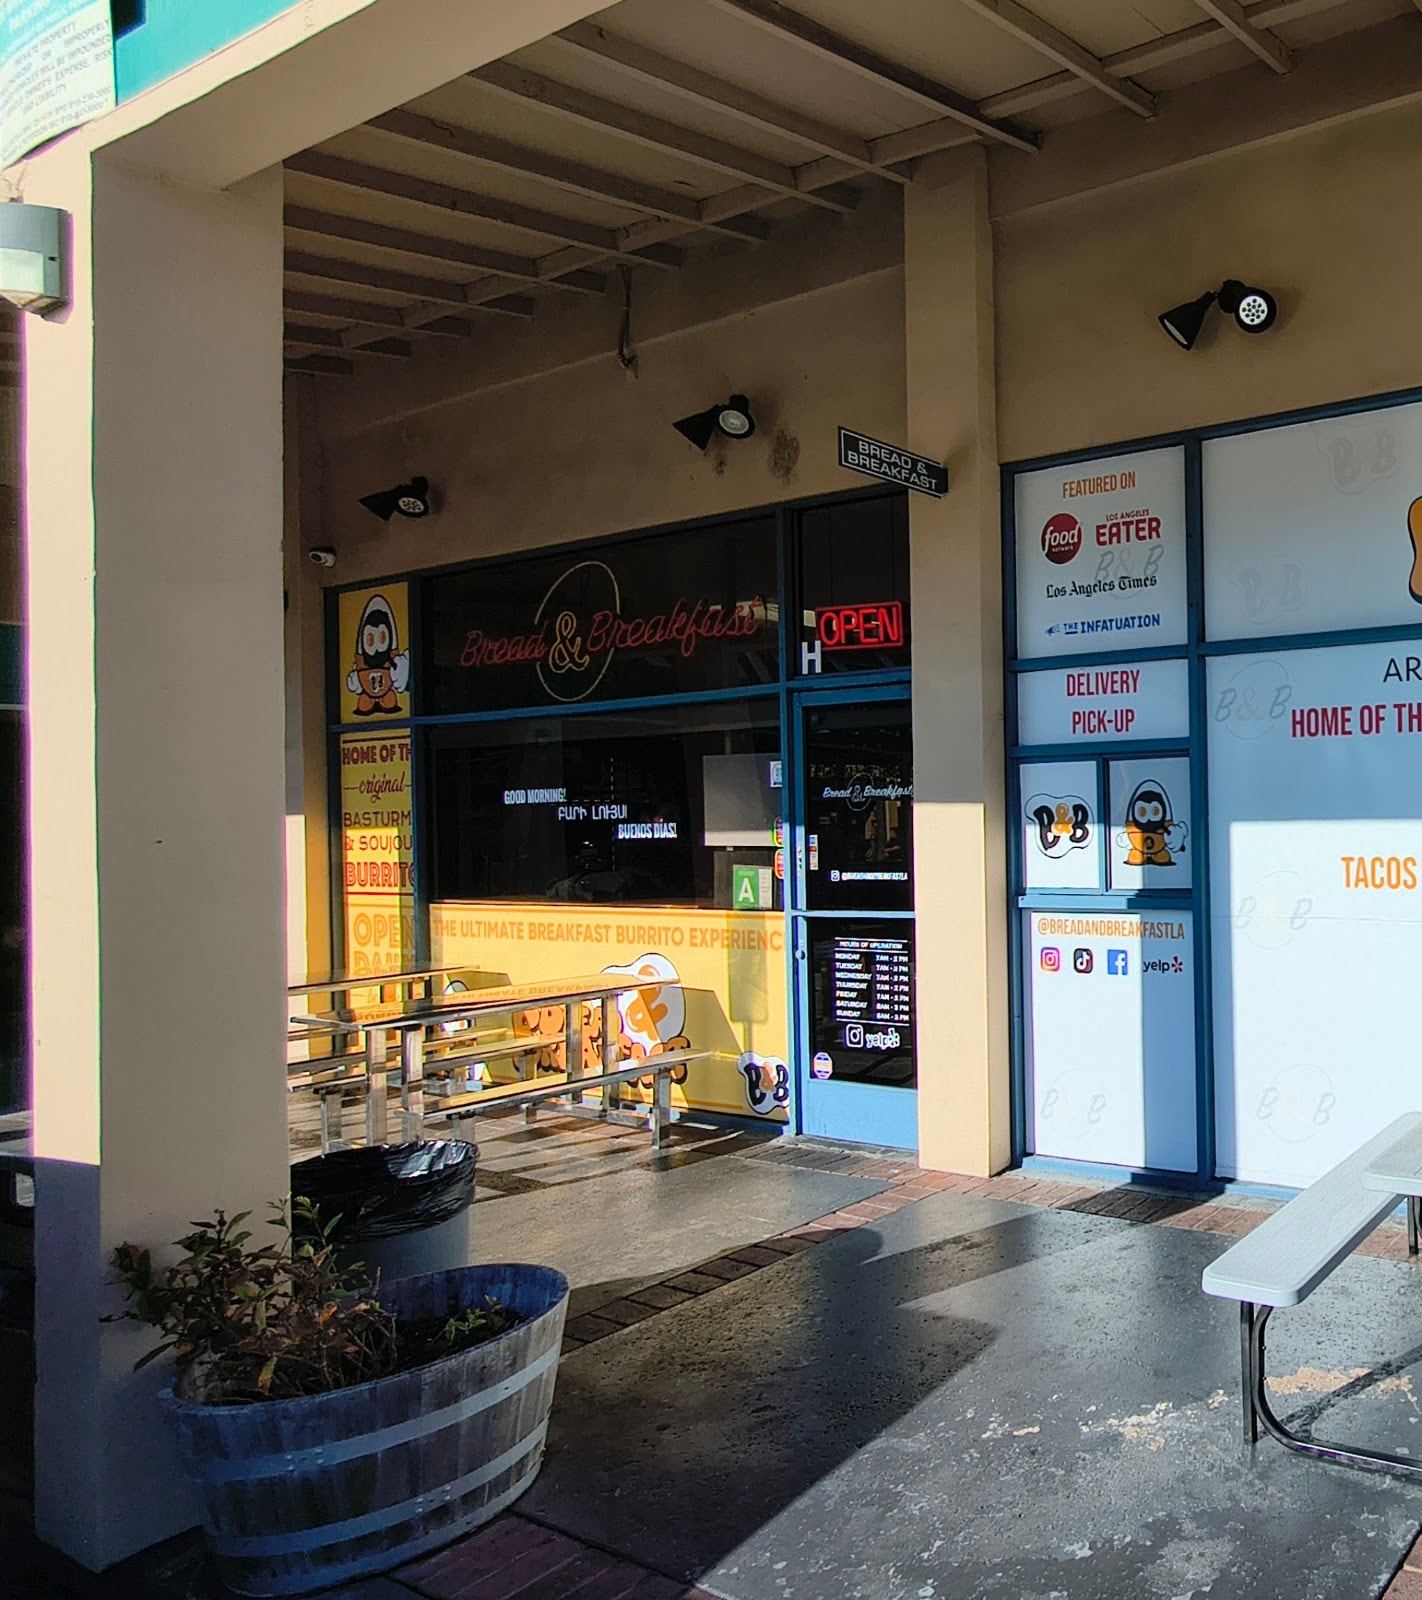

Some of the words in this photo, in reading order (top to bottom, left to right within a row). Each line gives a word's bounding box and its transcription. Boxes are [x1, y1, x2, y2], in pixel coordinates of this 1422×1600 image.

[847, 450, 938, 491] BREAKFAST
[858, 439, 912, 470] BREAD
[916, 460, 929, 476] &
[1062, 474, 1118, 499] FEATURED
[1120, 471, 1136, 490] ON
[1106, 512, 1119, 522] LOS
[1120, 508, 1150, 520] ANGELES
[1043, 521, 1080, 553] food
[1095, 516, 1162, 548] EATER
[1046, 584, 1067, 599] Los
[1069, 580, 1116, 598] Angeles
[1118, 575, 1158, 592] Times
[819, 605, 899, 646] OPEN
[1064, 622, 1079, 631] THE
[1081, 613, 1161, 634] INFATUATION
[549, 610, 590, 674] &
[1066, 669, 1140, 698] DELIVERY
[1072, 708, 1135, 735] PICK-UP
[1291, 706, 1353, 739] HOME
[1359, 704, 1387, 736] OF
[342, 745, 377, 765] HOME
[380, 743, 397, 763] OF
[358, 771, 406, 803] original
[503, 789, 526, 805] GOOD
[527, 788, 567, 803] MORNING!
[822, 786, 852, 799] Bread
[617, 823, 652, 840] BUENOS
[1341, 856, 1418, 890] TACOS
[738, 877, 756, 903] A
[432, 918, 457, 938] THE
[460, 920, 525, 941] ULTIMATE
[528, 922, 612, 945] BREAKFAST
[616, 924, 685, 947] BURRITO
[1037, 917, 1186, 940] @BREADANDBREAKFASTLA
[1142, 956, 1171, 975] yelp
